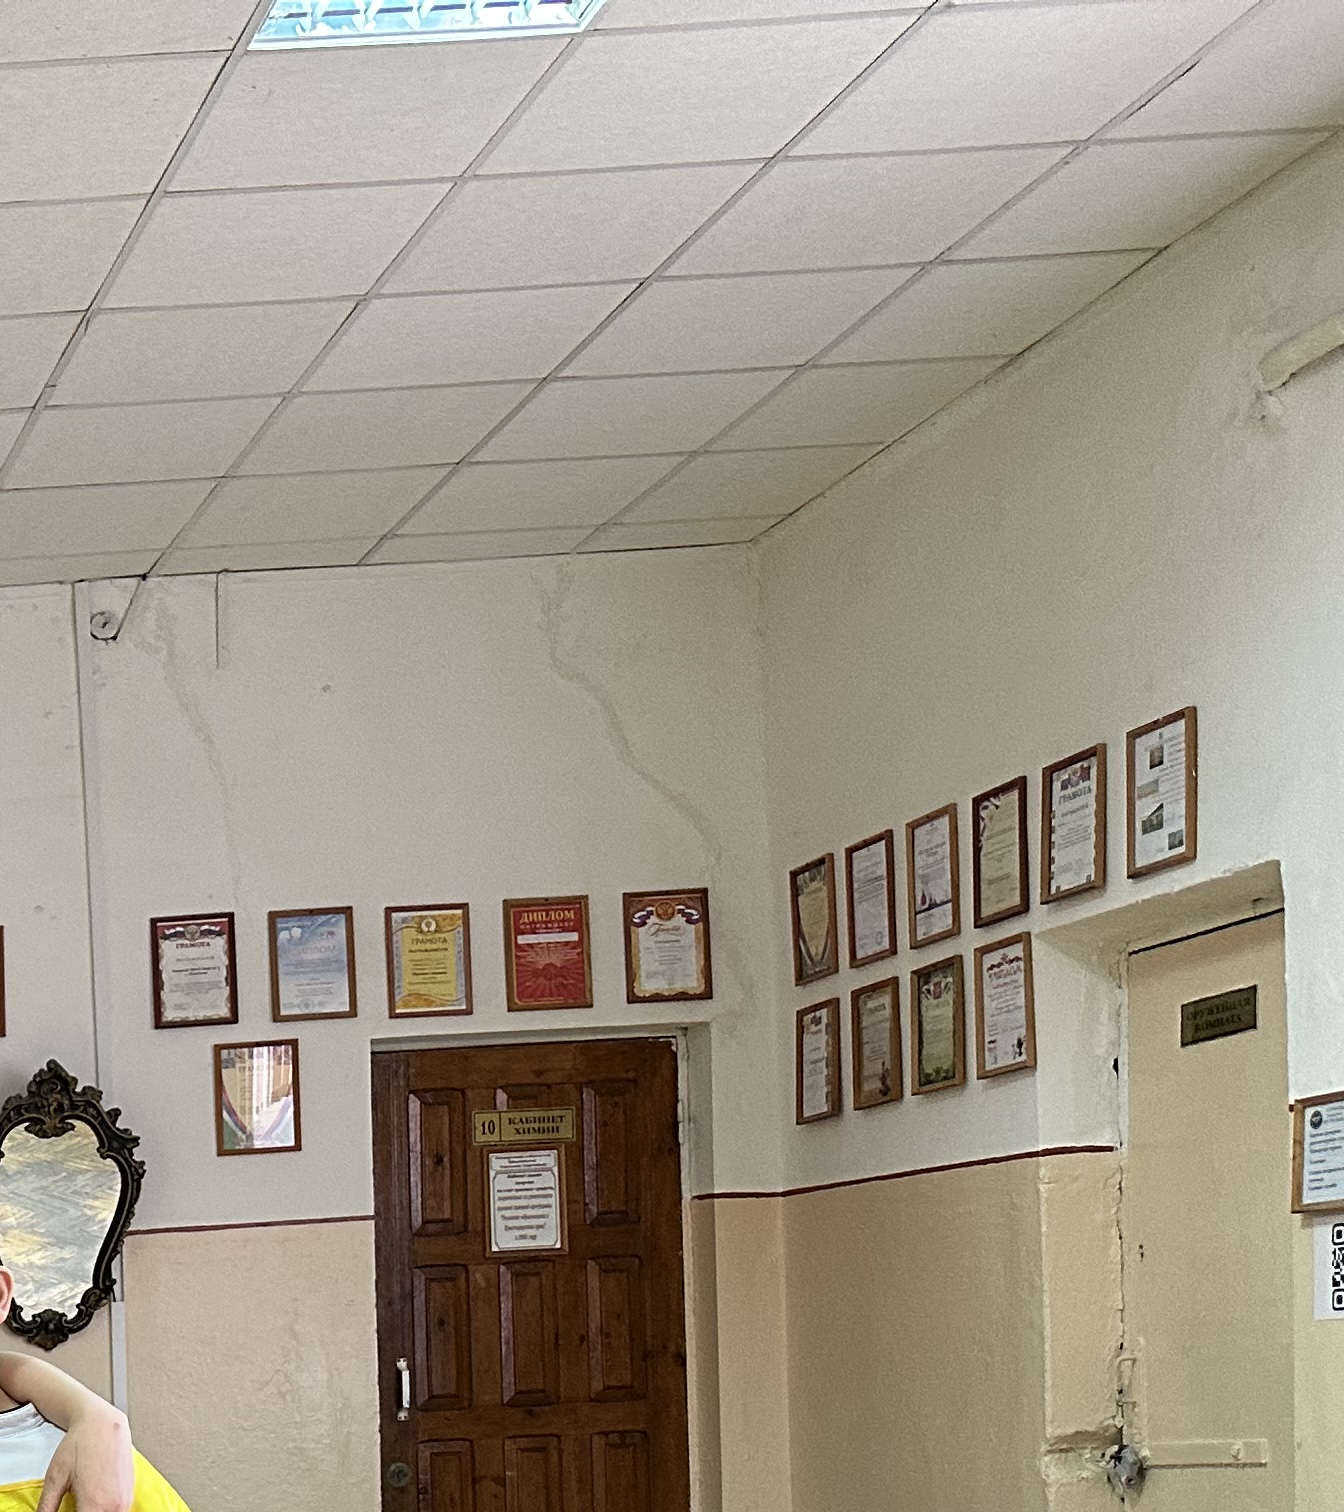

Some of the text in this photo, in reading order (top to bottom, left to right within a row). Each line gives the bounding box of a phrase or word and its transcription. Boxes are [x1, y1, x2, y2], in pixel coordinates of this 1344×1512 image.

[519, 909, 576, 924] ДИПЛОМ
[175, 941, 211, 950] ГРАМОТА
[411, 936, 448, 946] ГРАМОТА
[507, 1115, 565, 1126] КАБИНЕТ
[481, 1119, 496, 1136] 10
[513, 1125, 560, 1136] ХИМИИ
